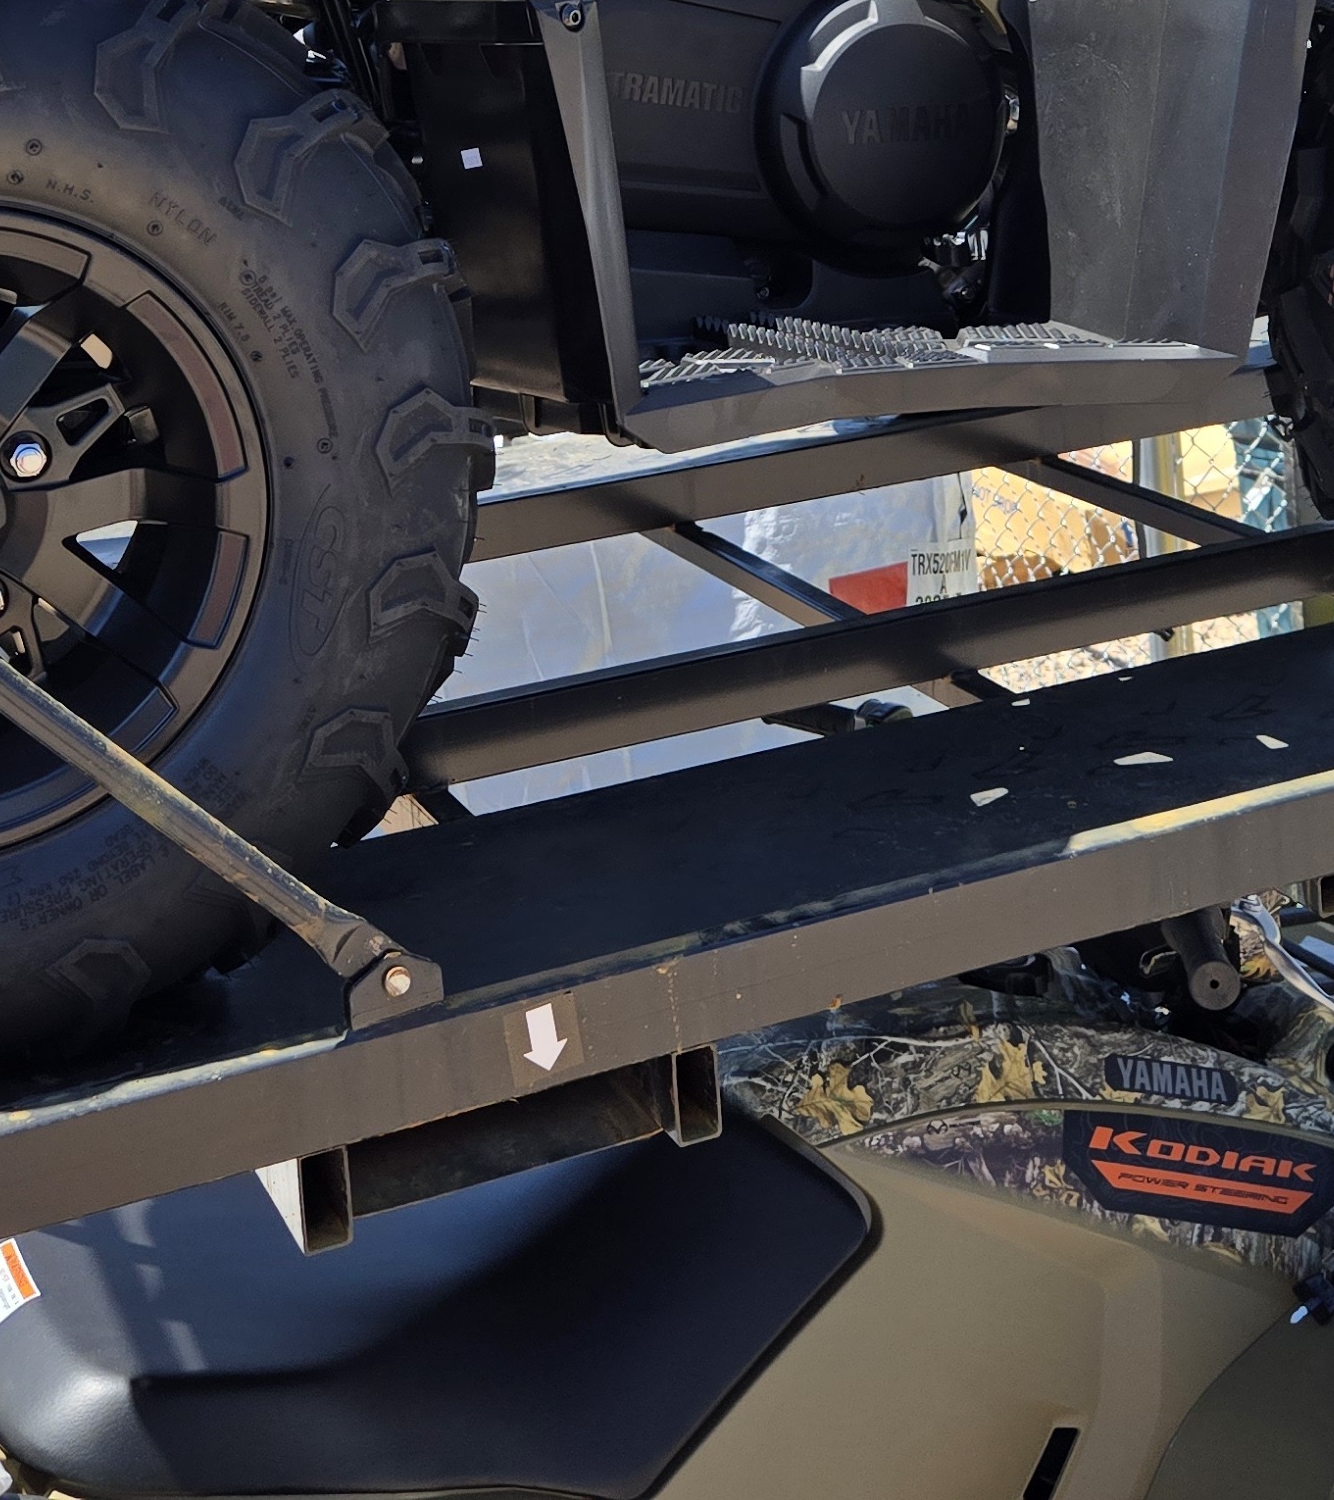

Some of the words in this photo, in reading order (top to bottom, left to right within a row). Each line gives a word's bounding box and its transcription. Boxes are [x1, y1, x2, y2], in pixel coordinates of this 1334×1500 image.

[1117, 1056, 1228, 1101] YAMAHA
[1088, 1125, 1316, 1182] KODIAK
[1117, 1171, 1189, 1191] POWER
[1194, 1182, 1288, 1206] STEERING
